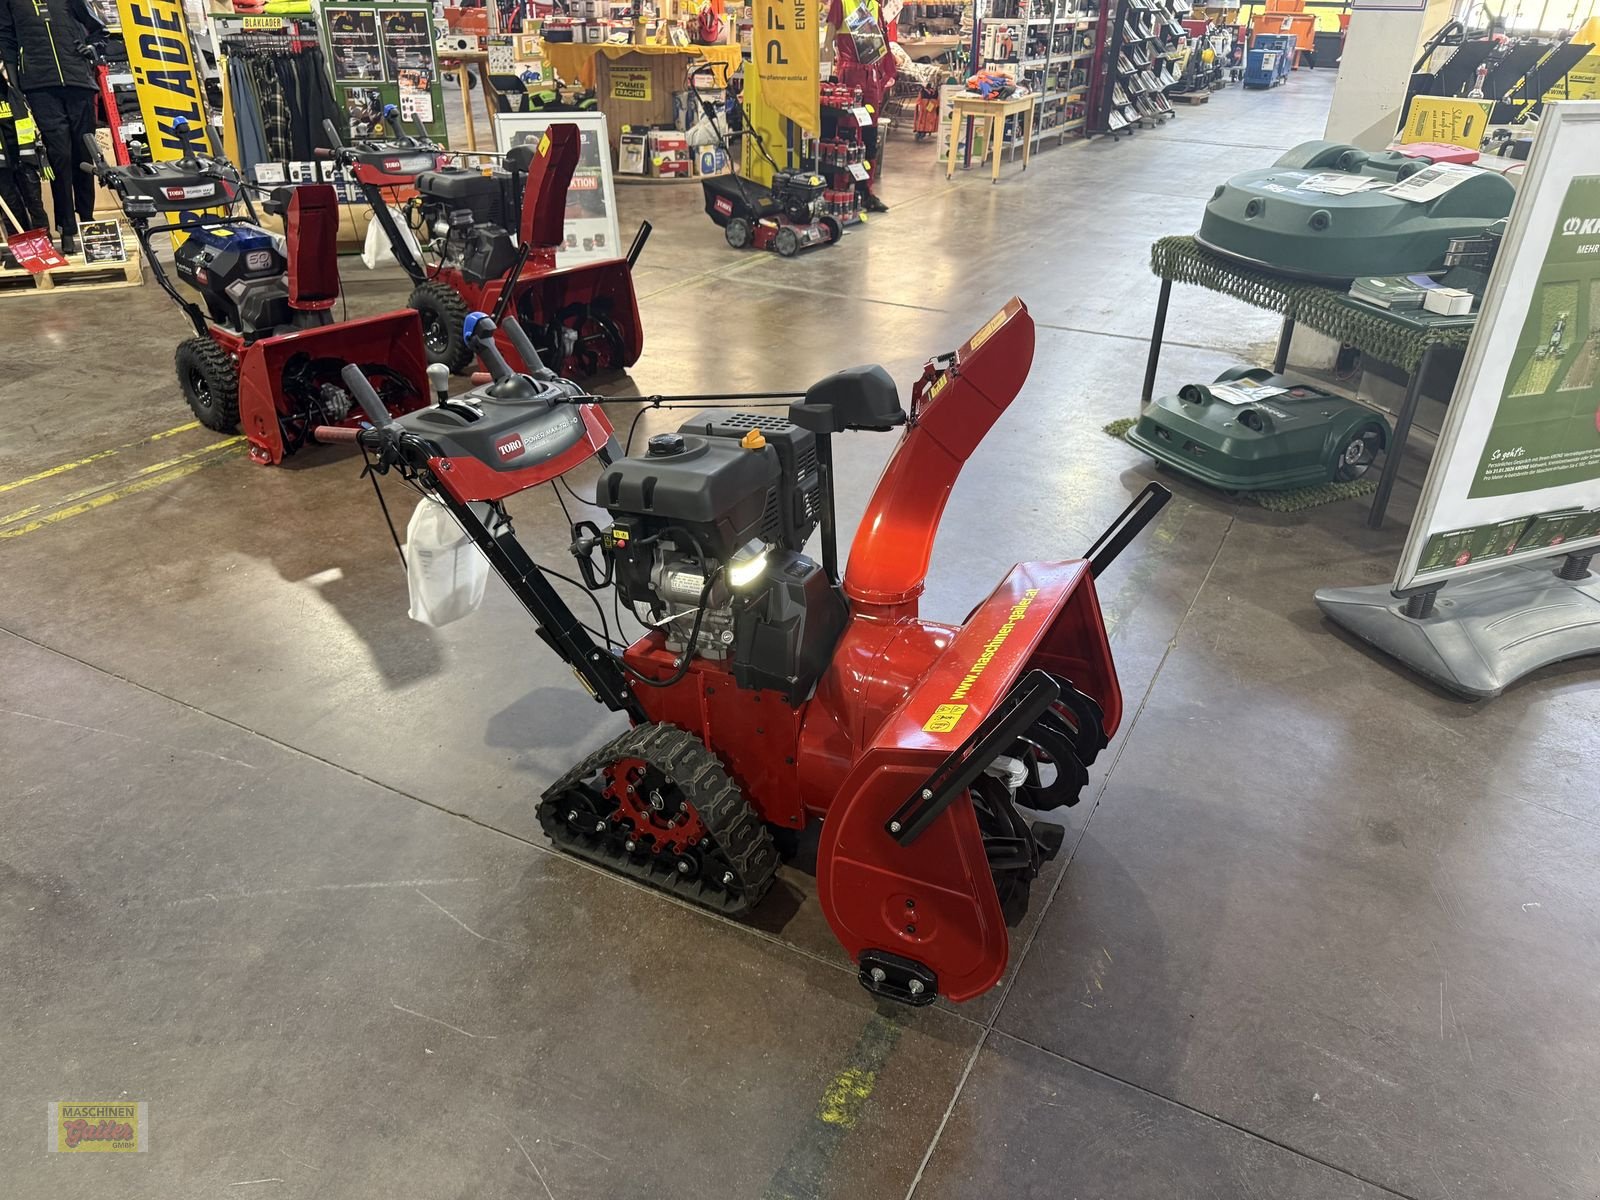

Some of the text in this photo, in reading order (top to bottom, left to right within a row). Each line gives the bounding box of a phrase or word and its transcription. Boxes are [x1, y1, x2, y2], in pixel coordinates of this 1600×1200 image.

[570, 178, 595, 187] KTION
[1576, 245, 1600, 254] MEHR
[498, 439, 522, 456] TORO
[525, 431, 545, 445] POWER
[1491, 449, 1501, 461] So
